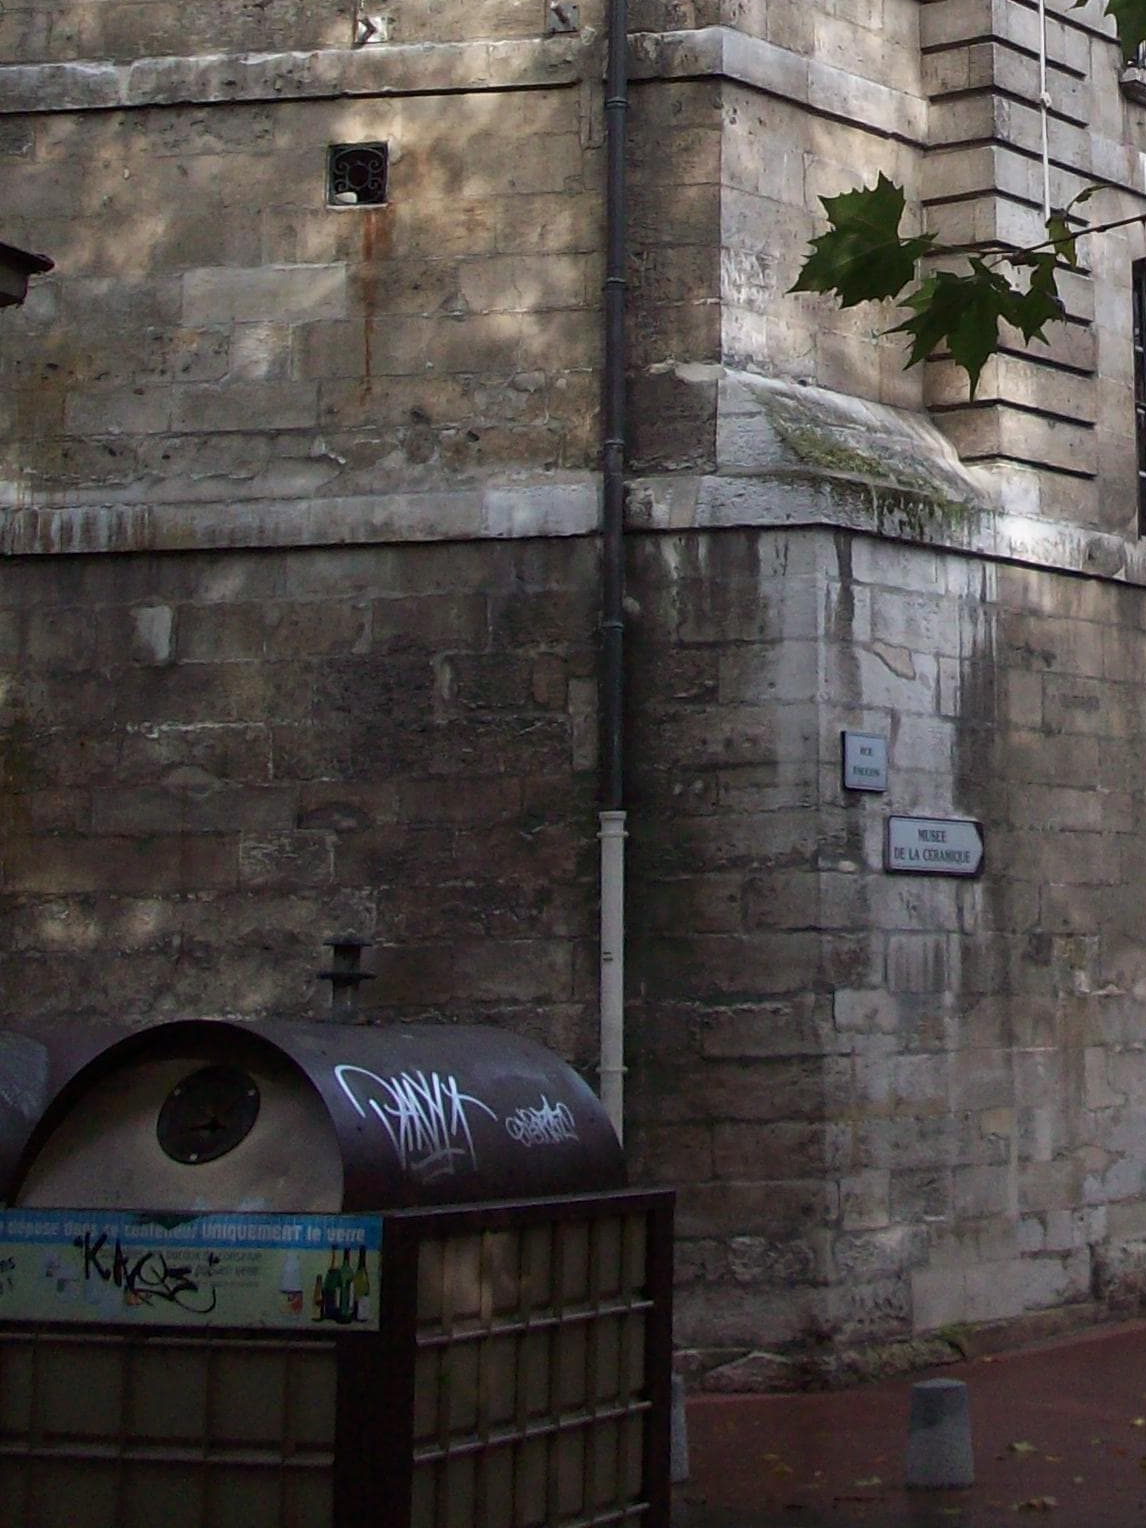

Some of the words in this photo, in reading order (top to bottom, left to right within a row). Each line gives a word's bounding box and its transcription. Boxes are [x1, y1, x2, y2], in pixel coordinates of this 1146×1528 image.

[894, 847, 906, 861] DE
[908, 847, 921, 862] LA
[307, 1224, 322, 1241] le
[327, 1226, 366, 1242] verre
